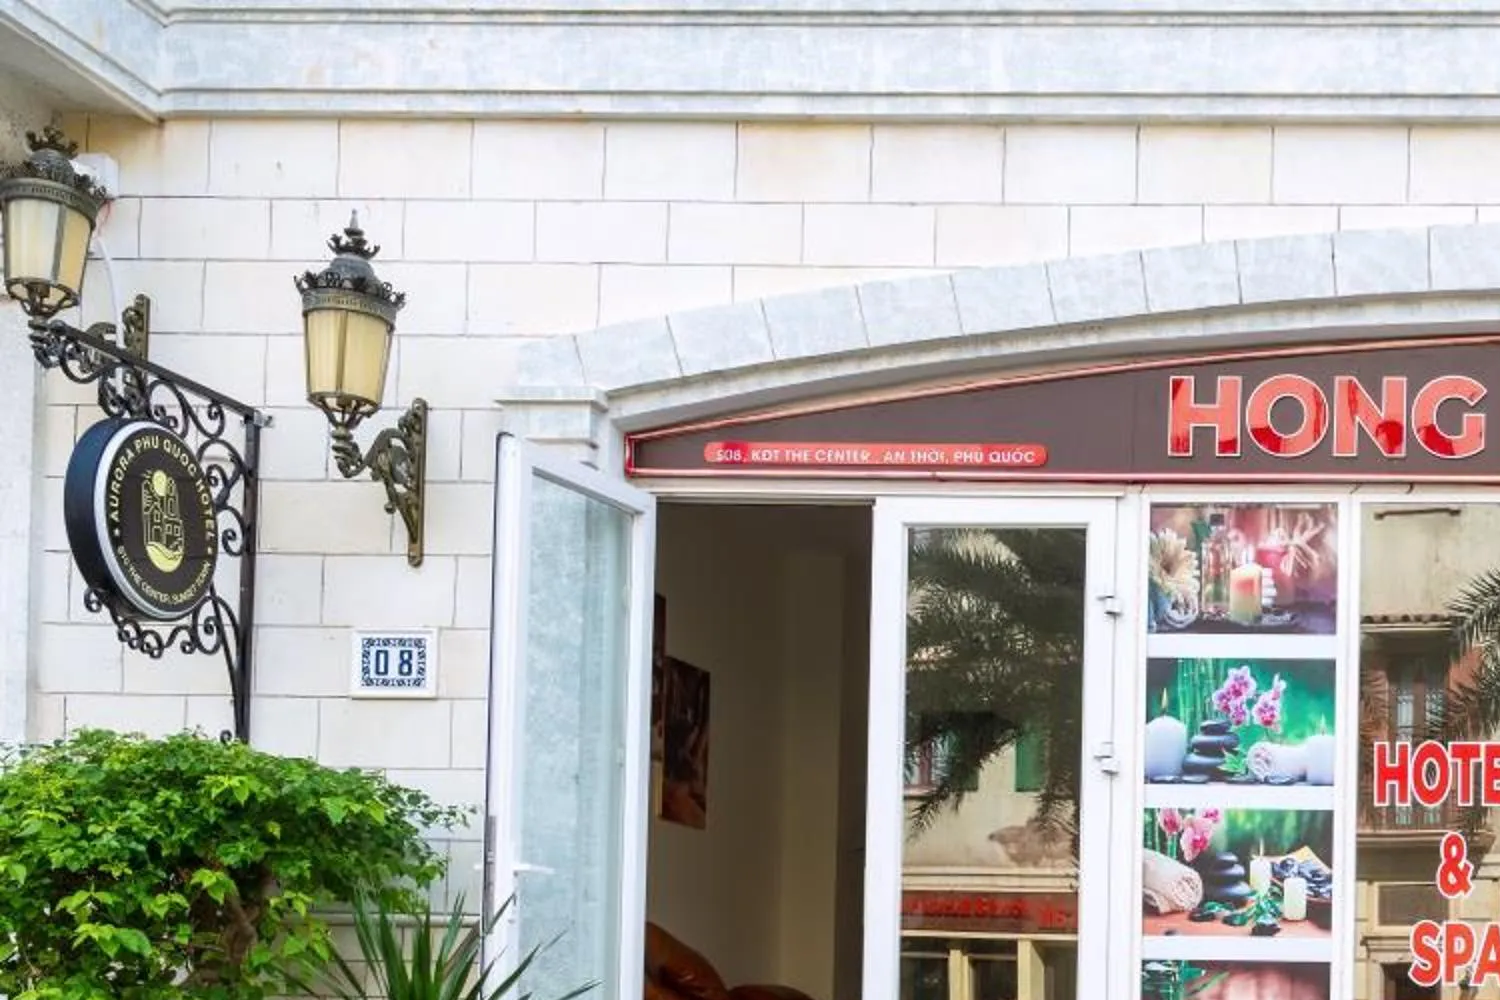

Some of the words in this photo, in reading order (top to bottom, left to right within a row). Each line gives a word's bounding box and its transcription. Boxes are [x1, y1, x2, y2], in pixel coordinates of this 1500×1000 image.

[1166, 374, 1487, 459] HONG
[109, 448, 135, 522] AURORA
[133, 436, 159, 453] PHU
[163, 438, 197, 477] QUOC
[195, 478, 215, 540] HOTEL
[785, 449, 809, 463] THE
[1436, 832, 1474, 898] &
